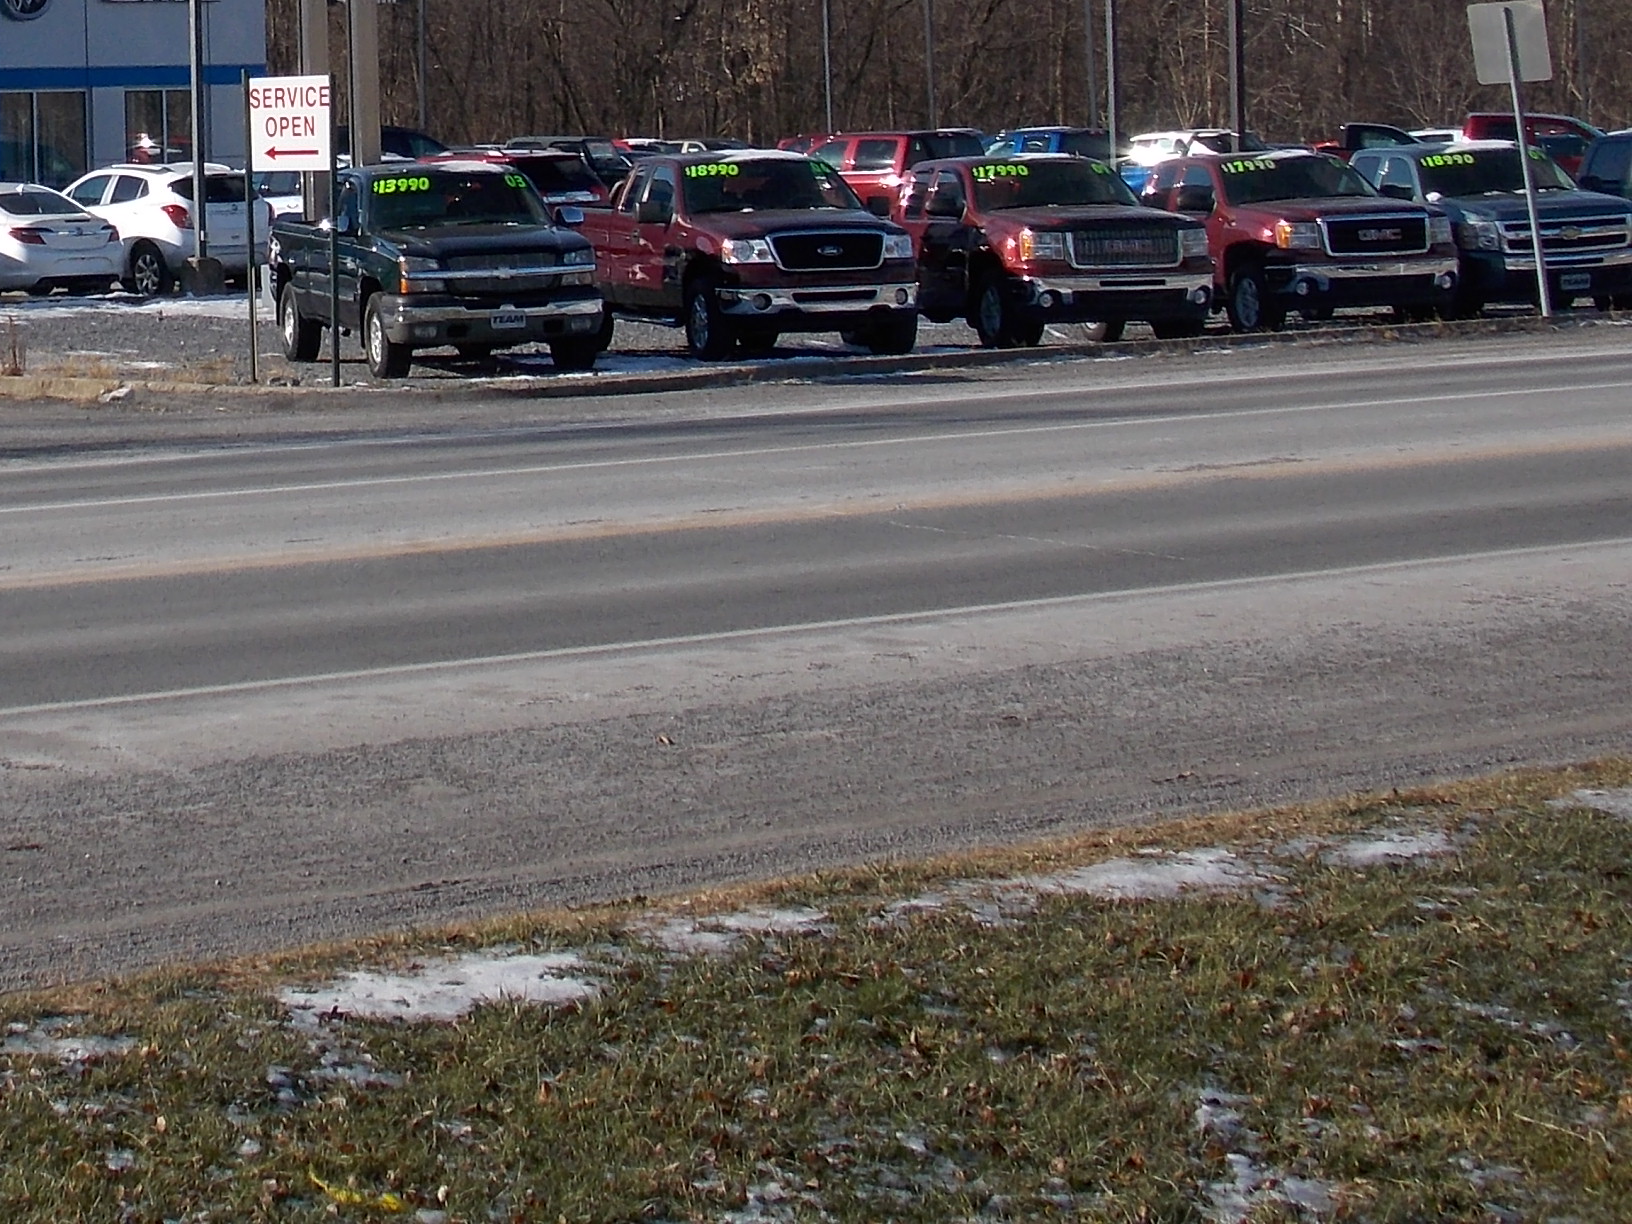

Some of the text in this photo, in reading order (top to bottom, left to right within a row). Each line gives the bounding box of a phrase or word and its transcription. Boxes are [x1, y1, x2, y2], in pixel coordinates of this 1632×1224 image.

[250, 86, 329, 109] SERVICE
[265, 116, 315, 137] OPEN
[373, 175, 527, 194] $13990 03
